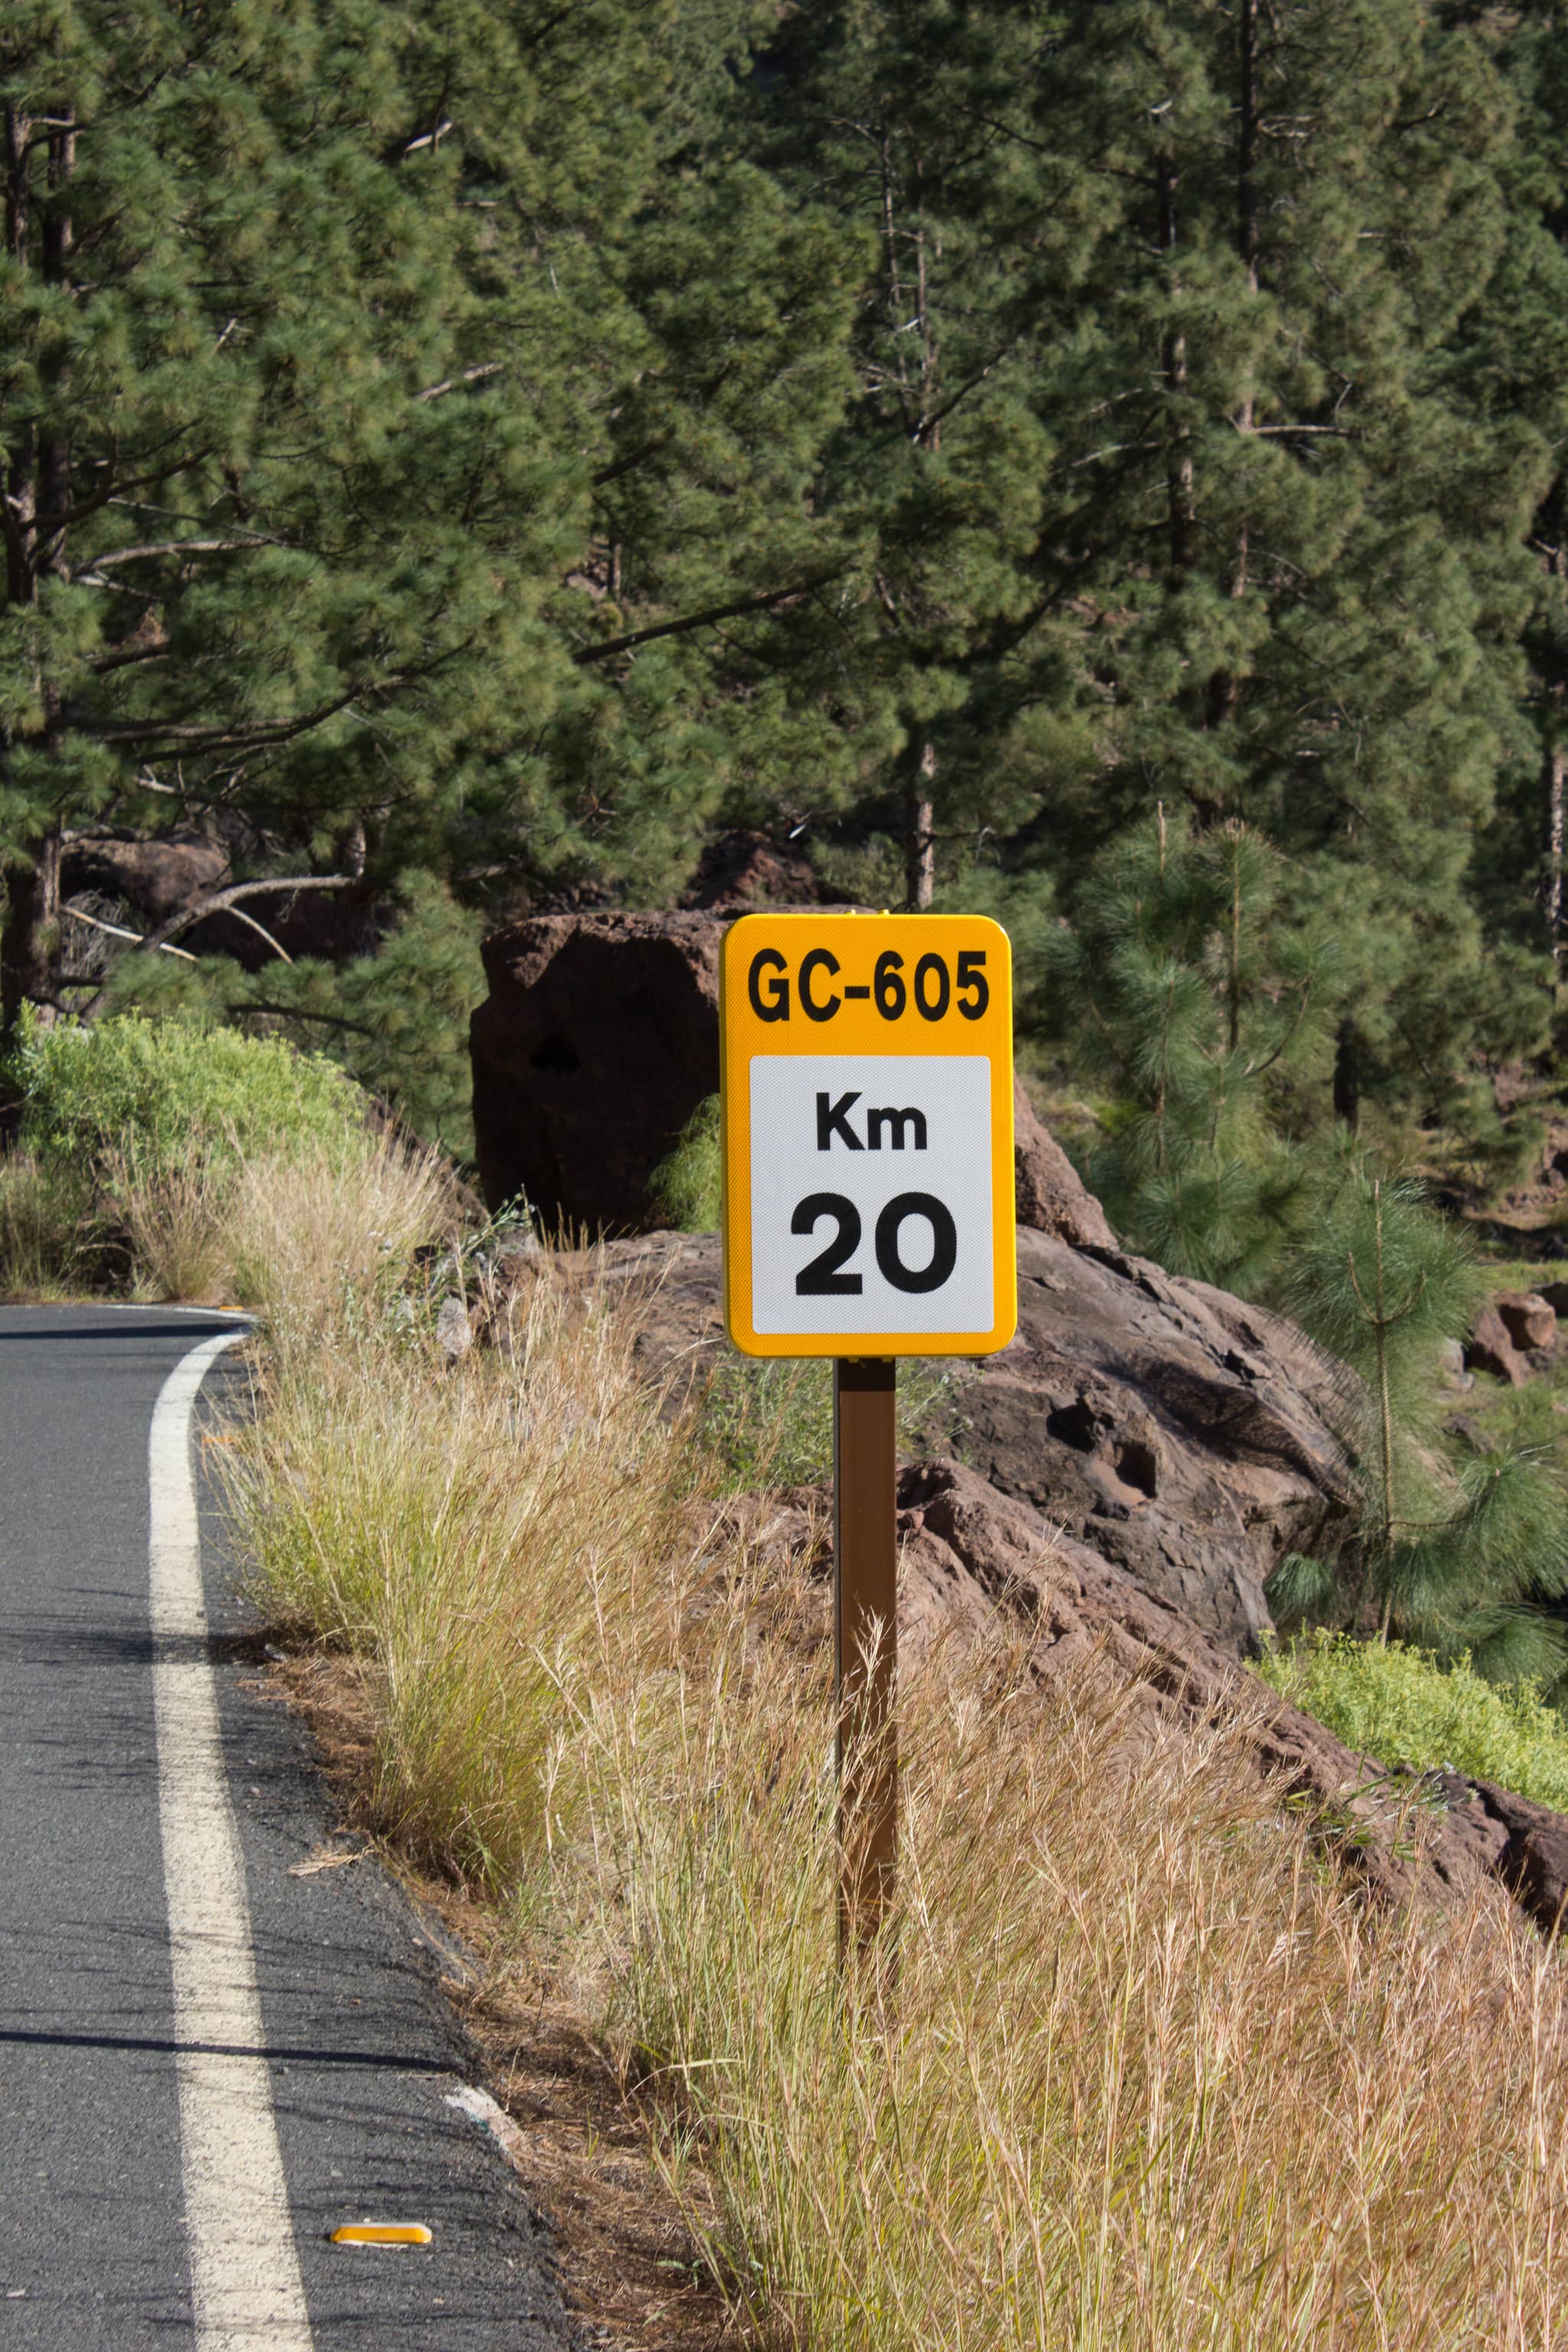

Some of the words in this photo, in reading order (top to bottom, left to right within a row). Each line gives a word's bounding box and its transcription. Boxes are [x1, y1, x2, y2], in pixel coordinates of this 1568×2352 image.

[748, 948, 989, 1022] GC-605
[816, 1092, 927, 1151] Km
[791, 1192, 957, 1295] 20
